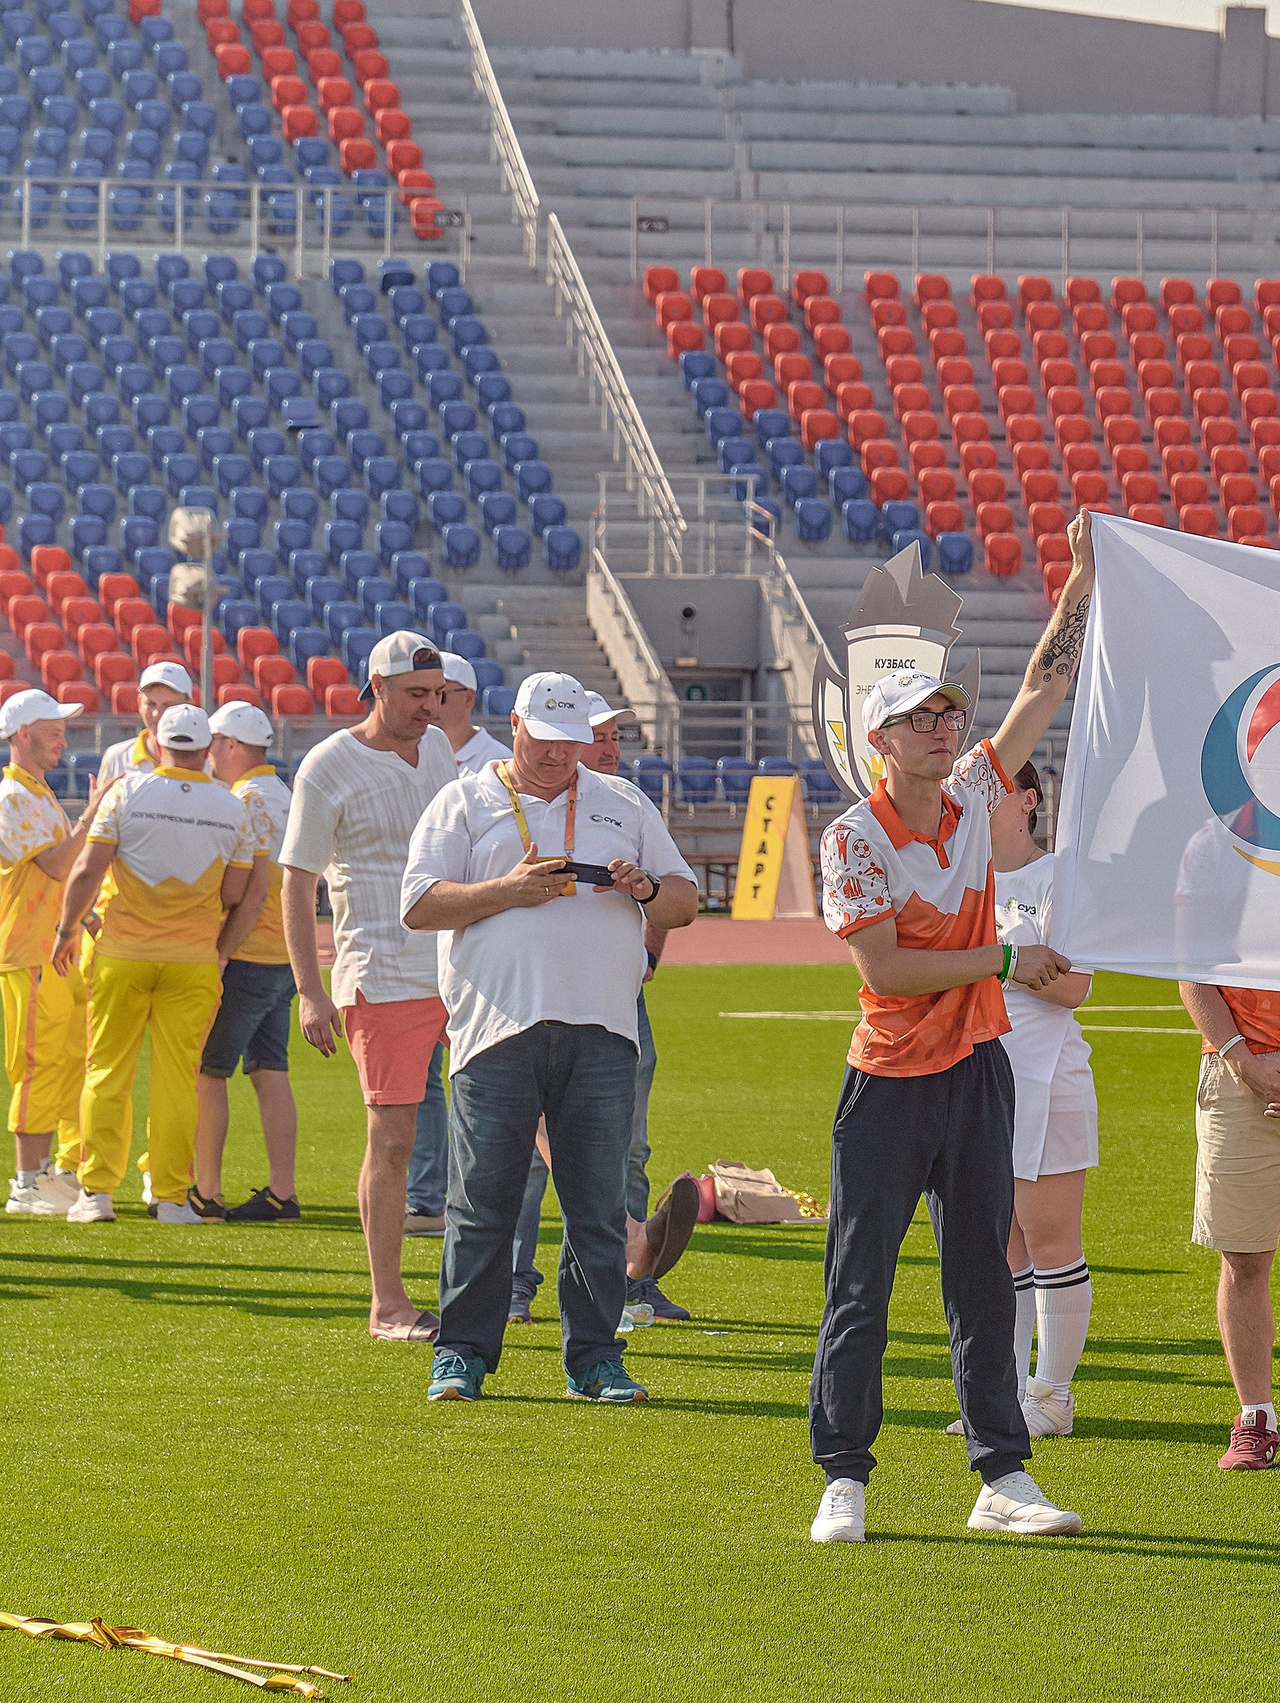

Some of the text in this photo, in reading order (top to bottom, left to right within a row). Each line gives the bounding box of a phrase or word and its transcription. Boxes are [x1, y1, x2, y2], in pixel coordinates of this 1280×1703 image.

[874, 658, 916, 670] КУЗБАСС
[752, 796, 775, 899] СТАРТ
[1017, 902, 1037, 915] СУЭ
